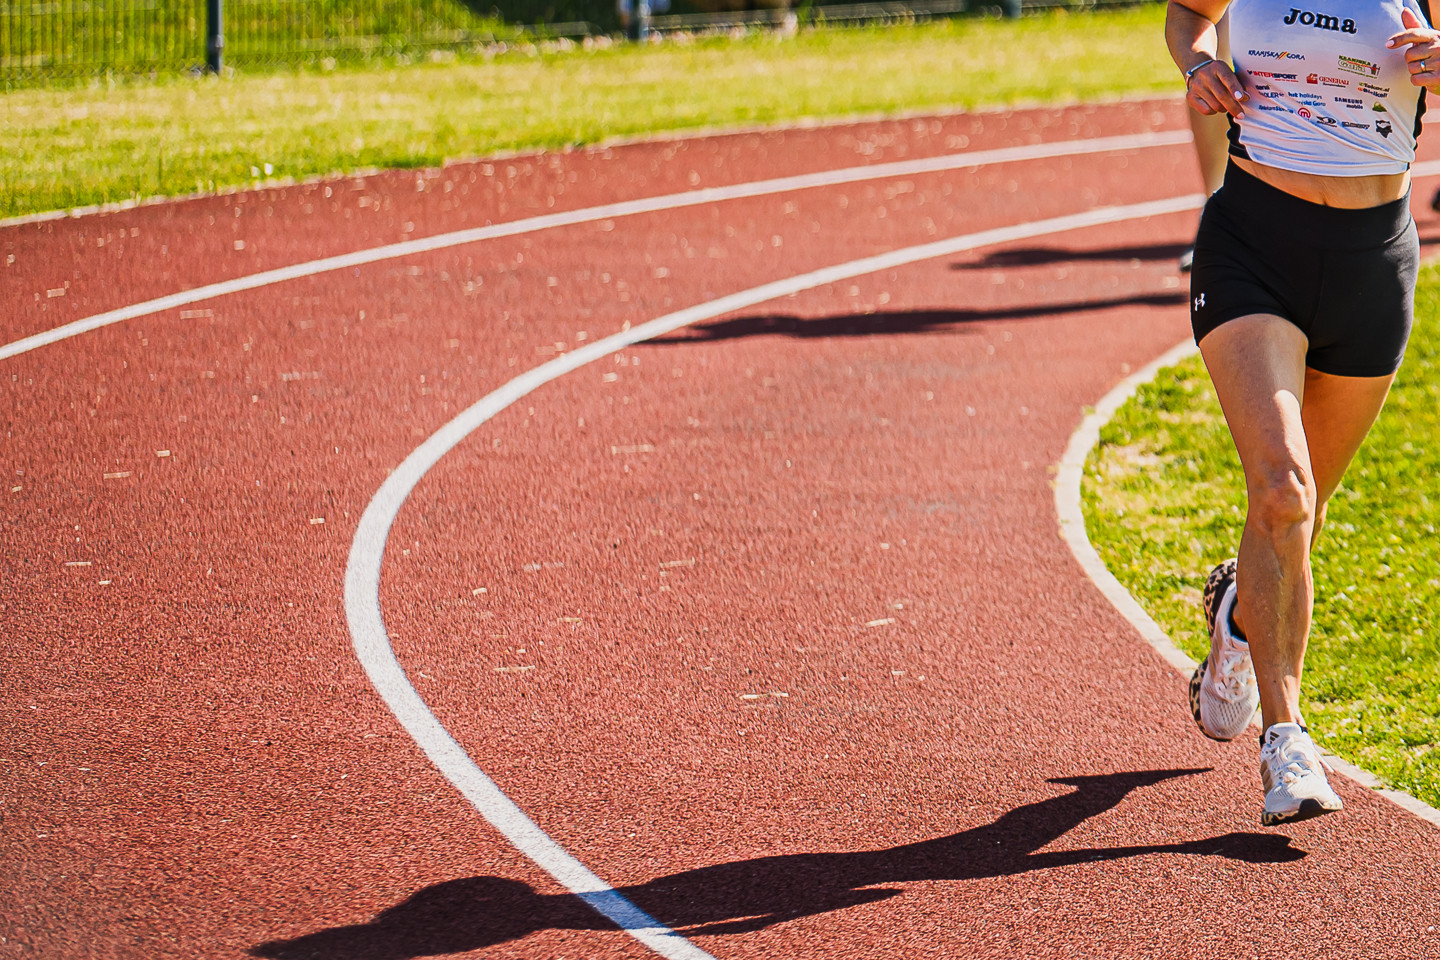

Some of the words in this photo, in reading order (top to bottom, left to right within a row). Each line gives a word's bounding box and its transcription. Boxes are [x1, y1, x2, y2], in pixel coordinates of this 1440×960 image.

[1284, 8, 1357, 34] Joma
[1287, 53, 1306, 61] GORA
[1253, 70, 1298, 79] INTERSPORT
[1319, 76, 1349, 85] GENERALI
[1334, 96, 1363, 104] SAMSUNG
